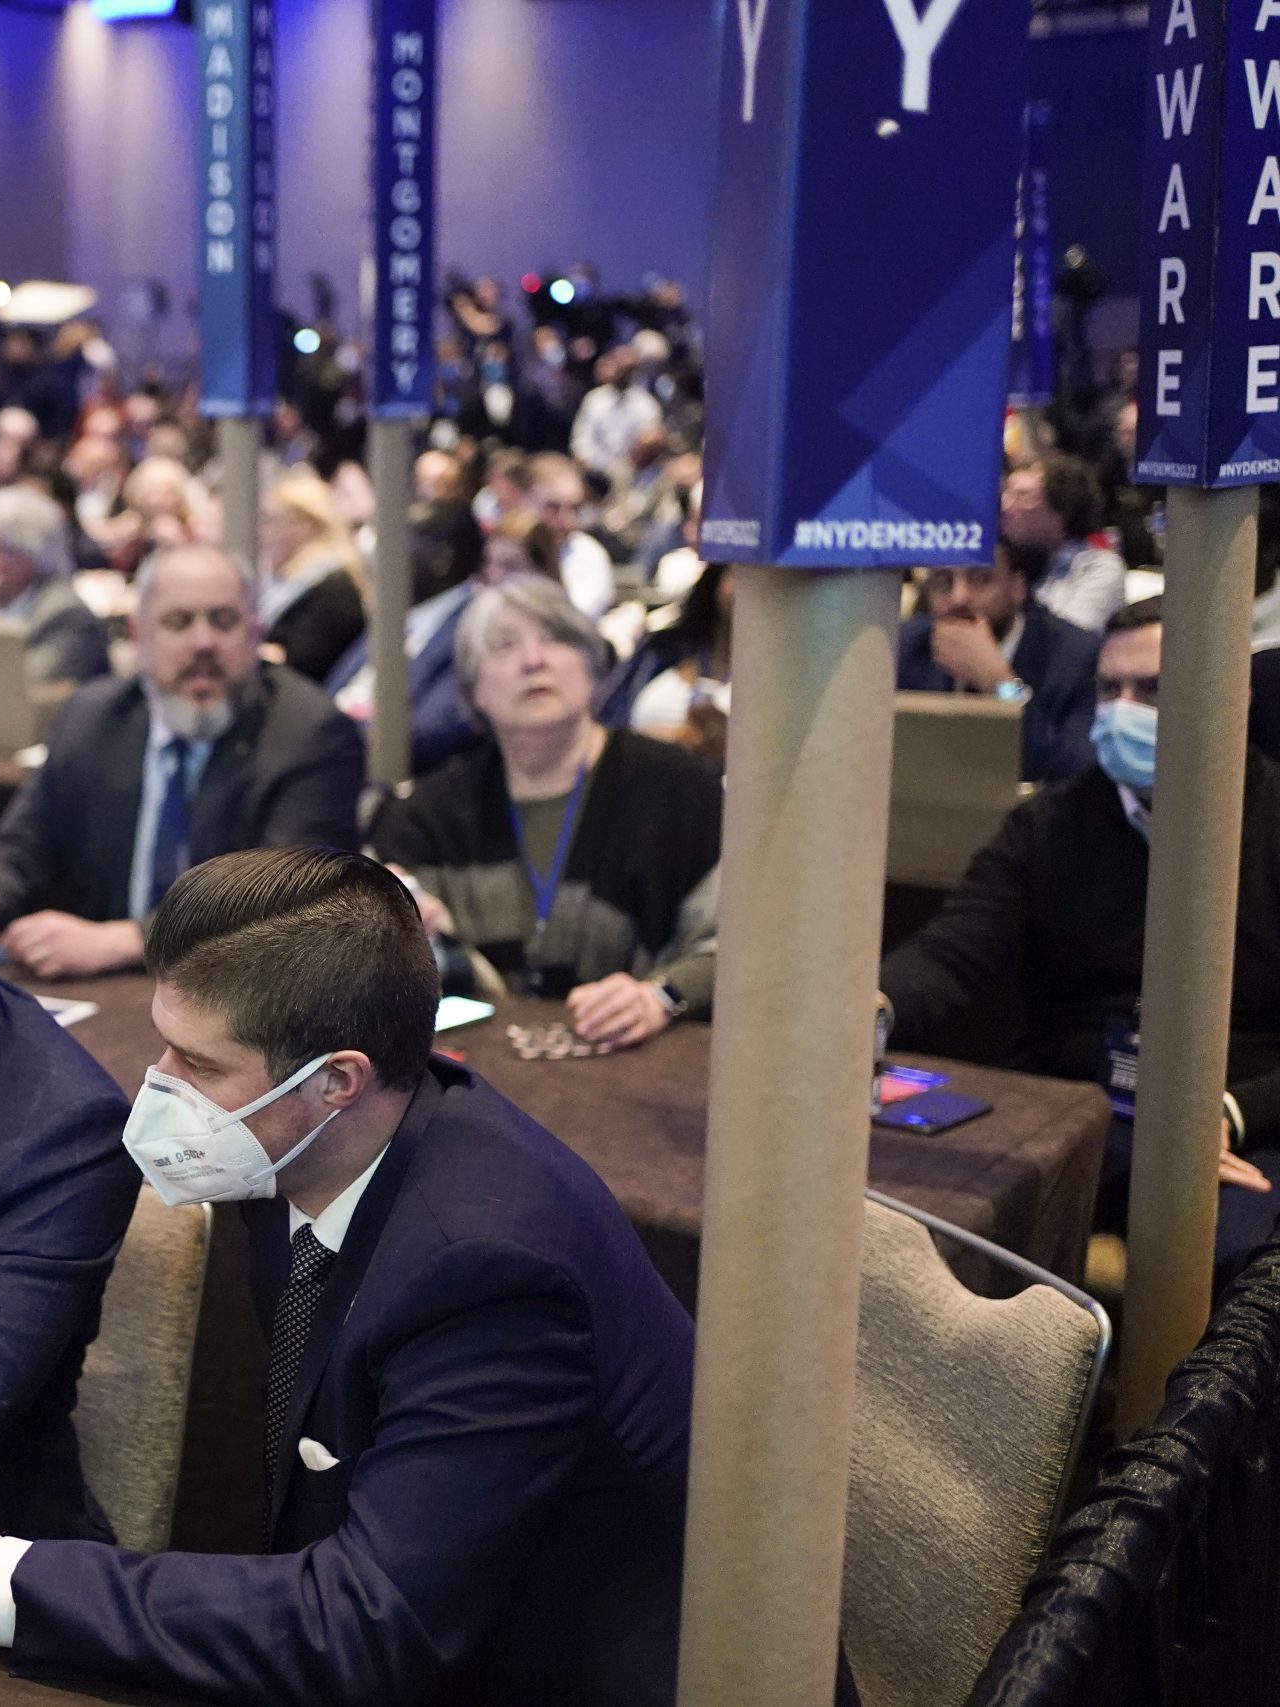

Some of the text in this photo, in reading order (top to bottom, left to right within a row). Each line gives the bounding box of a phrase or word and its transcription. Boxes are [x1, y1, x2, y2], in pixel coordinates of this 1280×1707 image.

[204, 4, 236, 275] MADISON
[390, 30, 424, 393] MONTGOMERY
[793, 518, 984, 551] #NYDEMS2022
[152, 1156, 173, 1168] 3M
